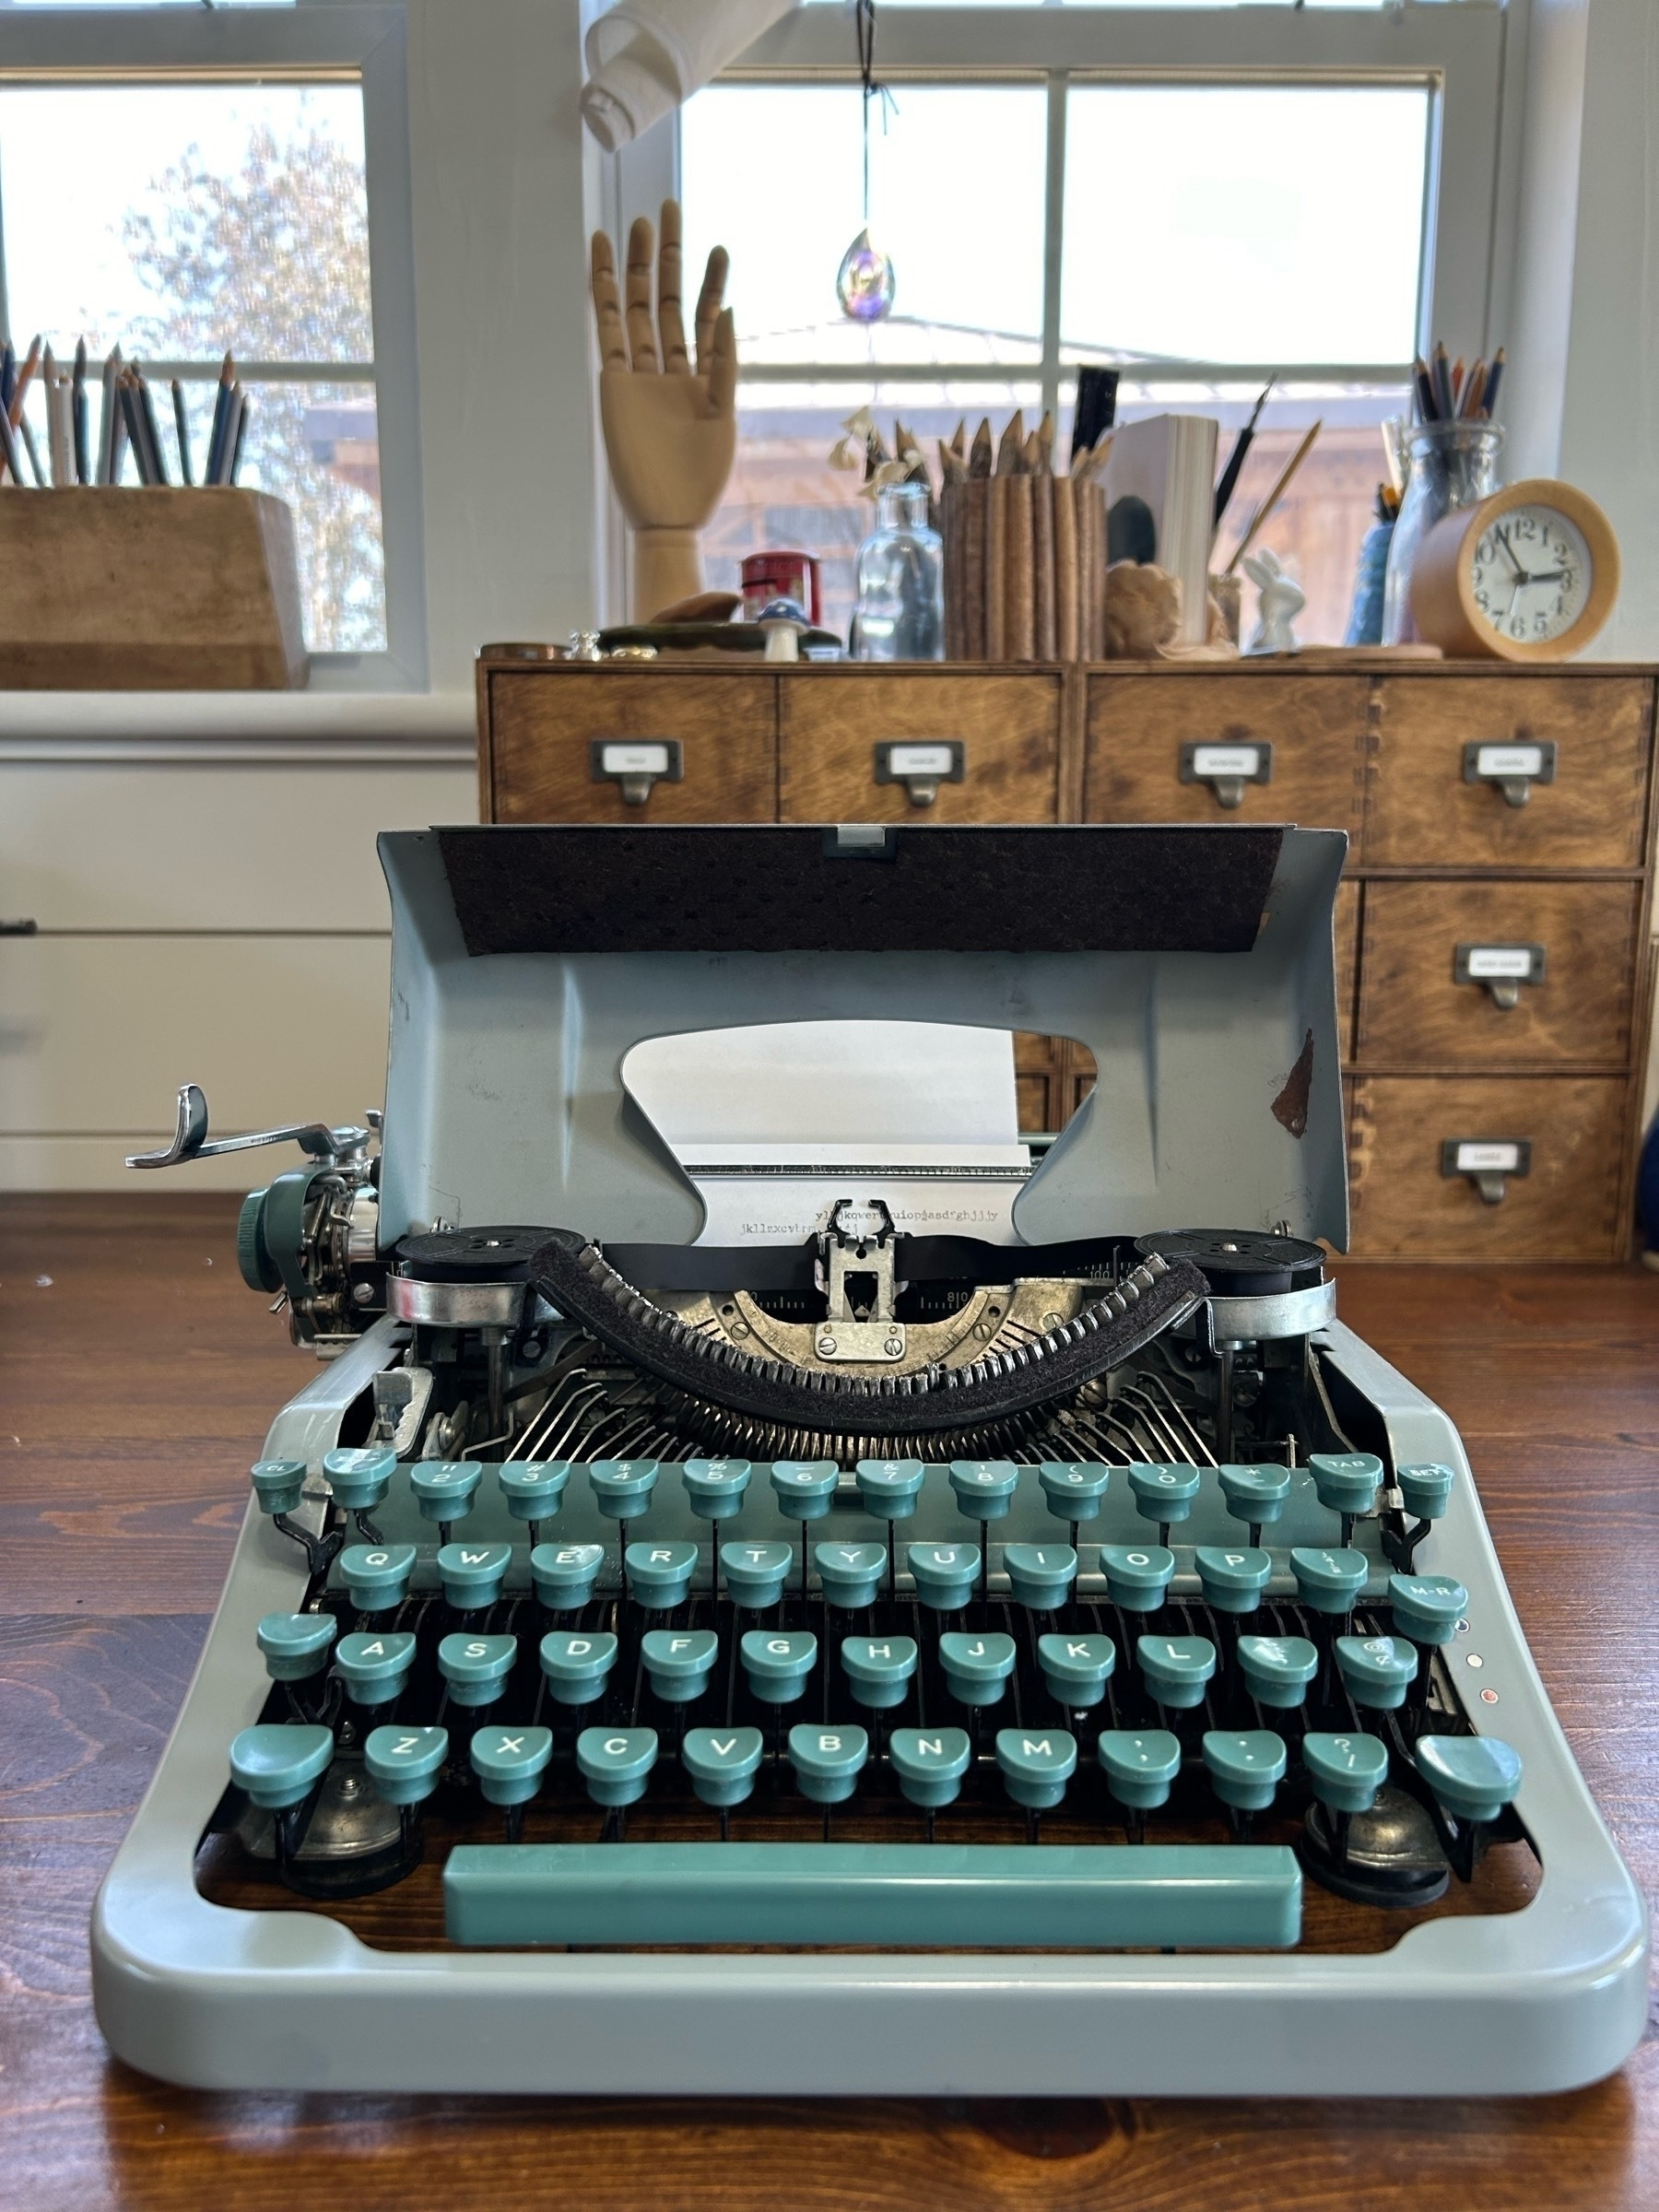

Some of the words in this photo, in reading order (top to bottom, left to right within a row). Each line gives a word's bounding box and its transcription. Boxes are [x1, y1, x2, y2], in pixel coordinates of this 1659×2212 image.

[1516, 518, 1536, 541] 12
[1541, 525, 1548, 547] 1
[1553, 542, 1567, 565] 2
[1472, 566, 1483, 589] 9
[1559, 569, 1572, 593] 3
[1475, 590, 1489, 613] 8
[1548, 595, 1562, 617] 4
[1491, 610, 1505, 631] 7
[1533, 611, 1547, 634] 5
[1510, 617, 1525, 640] 6
[266, 1465, 287, 1473] CL
[526, 1464, 547, 1473] #
[617, 1463, 631, 1472] $
[708, 1462, 727, 1471] %
[883, 1463, 900, 1472] &
[1068, 1465, 1077, 1474] (
[1158, 1465, 1169, 1476] )
[1327, 1460, 1367, 1469] TAB
[431, 1473, 451, 1484] 2
[522, 1473, 539, 1482] 3
[612, 1472, 630, 1481] 4
[706, 1471, 724, 1480] 5
[796, 1473, 813, 1482] 6
[884, 1471, 898, 1481] 7
[977, 1473, 994, 1482] 8
[1067, 1474, 1084, 1483] 9
[365, 1552, 390, 1566] Q
[461, 1550, 490, 1564] W
[555, 1550, 578, 1564] E
[650, 1550, 673, 1563] R
[746, 1550, 768, 1563] T
[840, 1550, 862, 1564] Y
[934, 1551, 957, 1564] U
[1037, 1551, 1046, 1565] I
[1126, 1552, 1150, 1566] O
[1224, 1554, 1246, 1567] P
[1409, 1584, 1452, 1598] M-R
[359, 1641, 384, 1656] A
[464, 1642, 488, 1658] S
[566, 1641, 593, 1656] D
[670, 1639, 692, 1653] F
[767, 1640, 791, 1654] G
[868, 1644, 891, 1659] H
[968, 1641, 985, 1657] J
[1066, 1642, 1091, 1658] K
[1166, 1643, 1192, 1659] L
[391, 1736, 419, 1754] Z
[496, 1735, 526, 1754] X
[604, 1737, 629, 1756] C
[711, 1737, 737, 1756] V
[818, 1735, 841, 1751] B
[918, 1737, 943, 1755] N
[1022, 1738, 1053, 1756] M
[1333, 1737, 1350, 1753] ?
